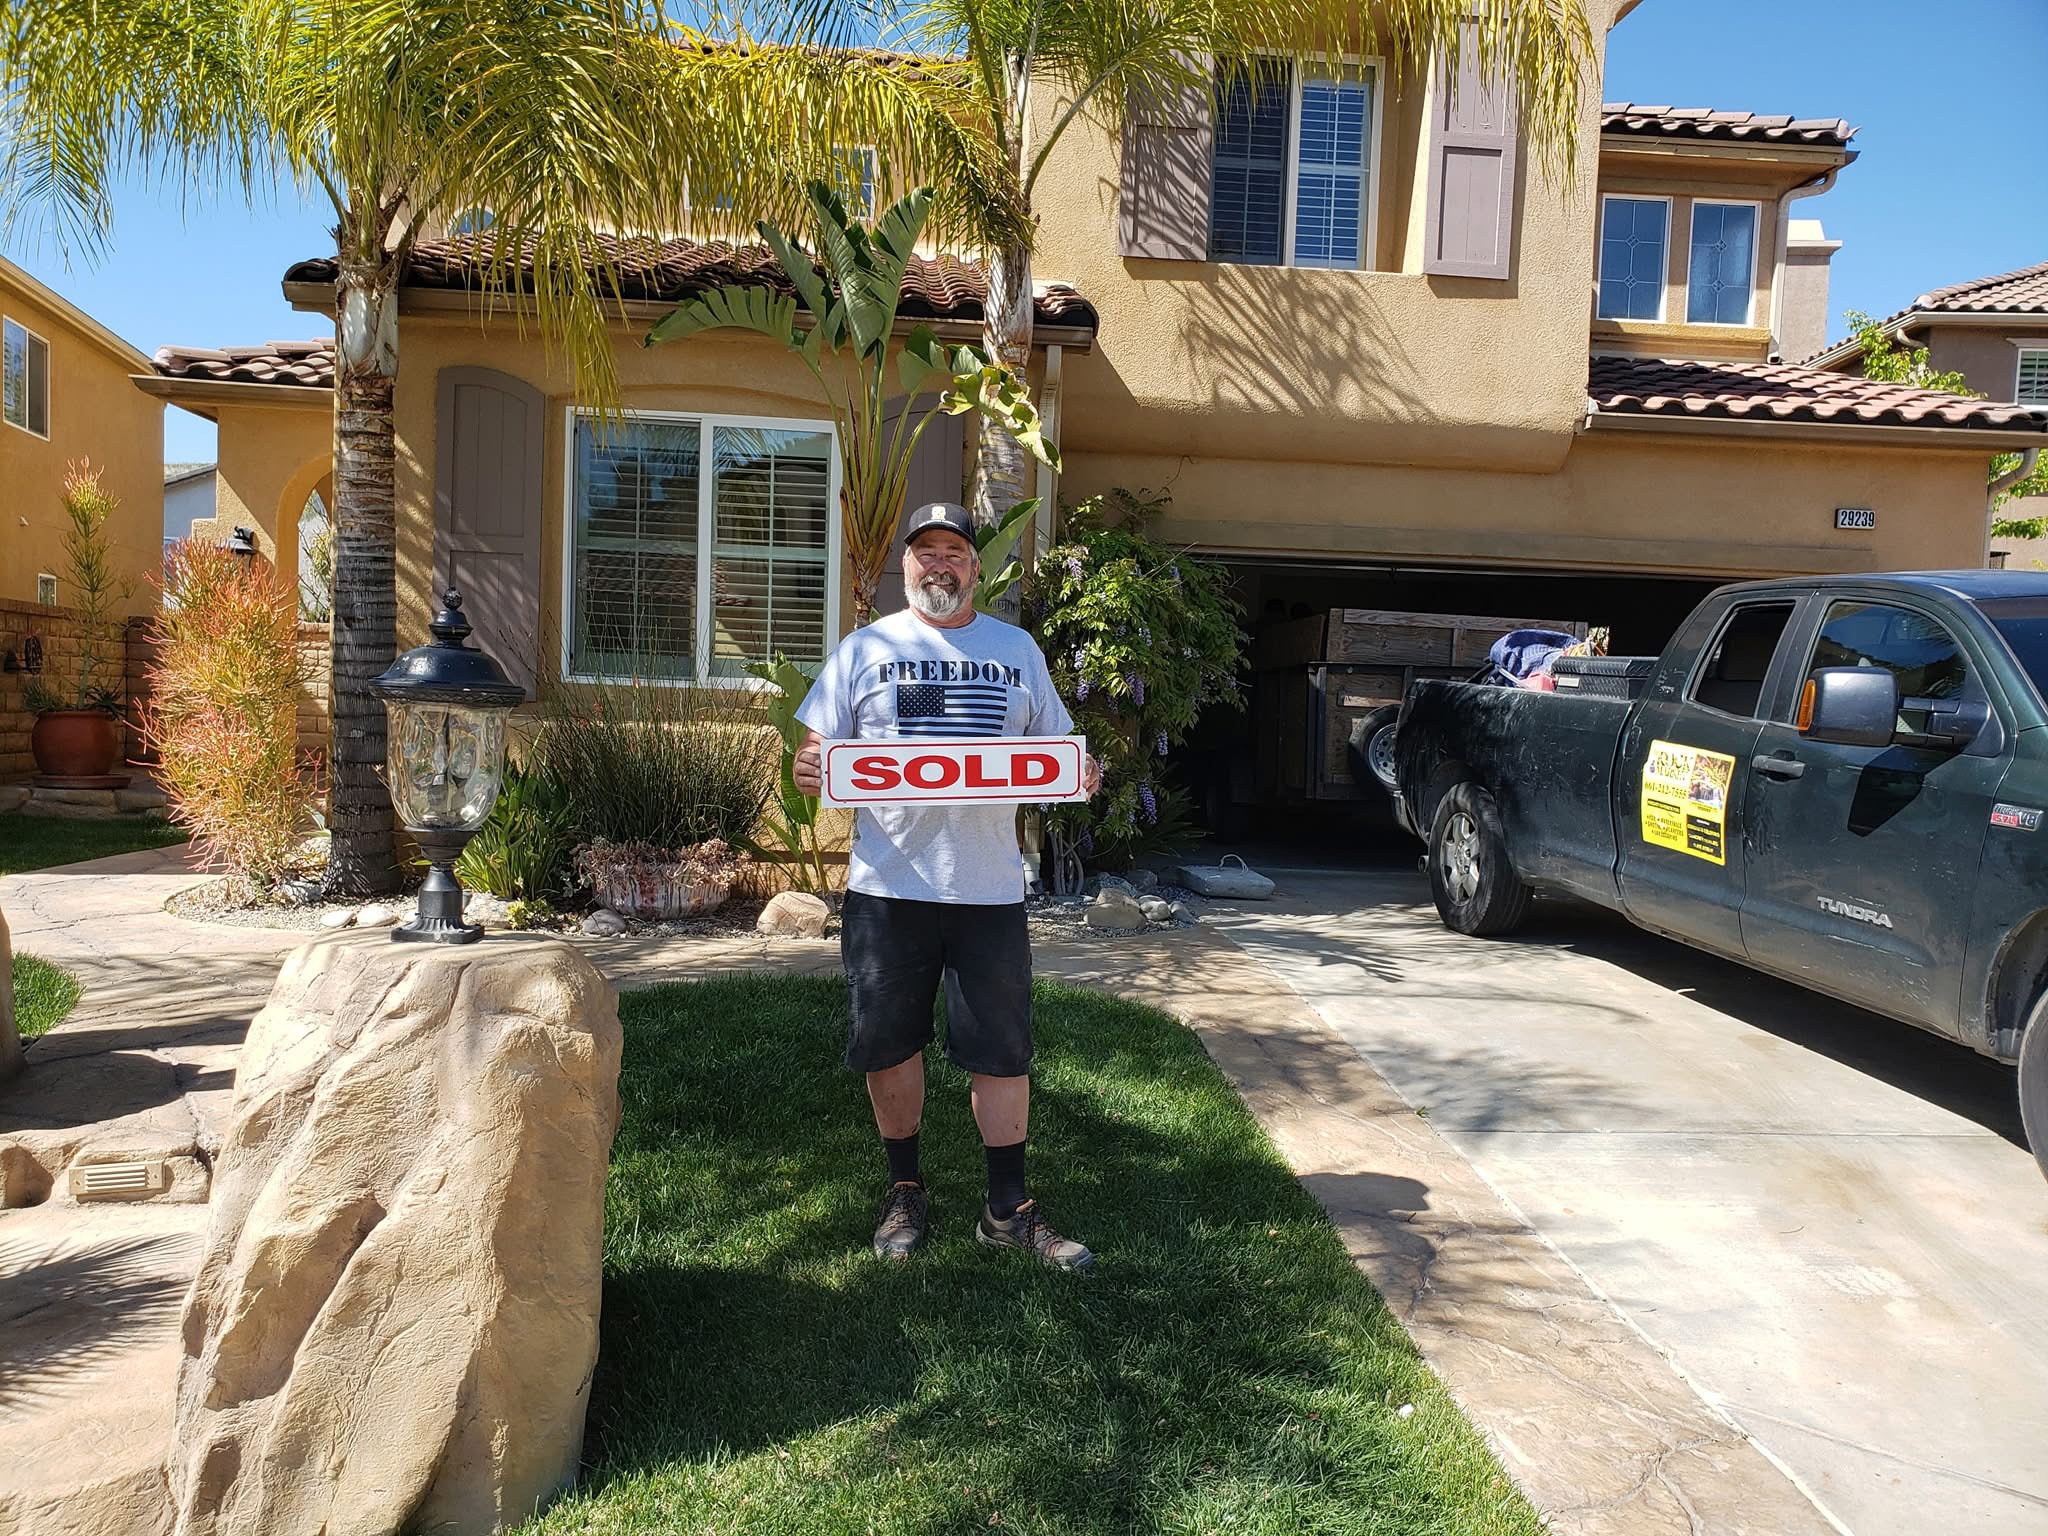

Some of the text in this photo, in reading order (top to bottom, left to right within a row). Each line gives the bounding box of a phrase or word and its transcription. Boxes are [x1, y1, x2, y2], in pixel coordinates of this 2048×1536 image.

[1841, 511, 1875, 527] 29239
[878, 660, 1022, 688] FREEDOM
[851, 753, 1060, 791] SOLD
[1817, 896, 1893, 928] TUNDRA
